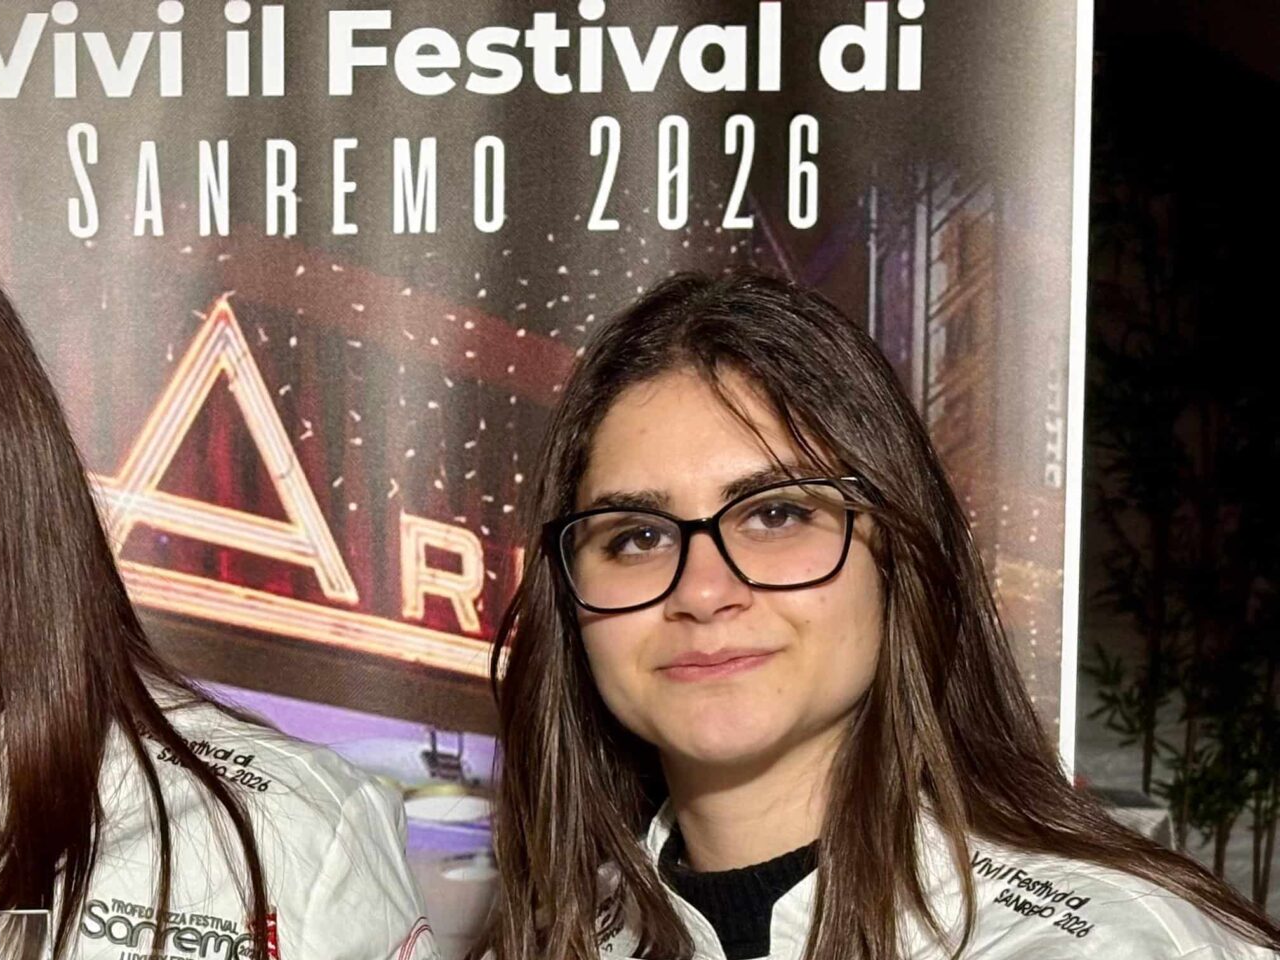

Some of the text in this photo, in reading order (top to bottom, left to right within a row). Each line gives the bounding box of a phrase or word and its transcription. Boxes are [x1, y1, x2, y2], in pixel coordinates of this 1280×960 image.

[224, 0, 285, 97] il
[328, 0, 782, 96] Festival
[819, 0, 926, 92] di
[66, 114, 820, 239] SANREMO 2026
[230, 769, 272, 793] 2026
[111, 898, 154, 919] TROFEO
[189, 912, 239, 936] FESTIVAL
[1053, 912, 1095, 938] 2026
